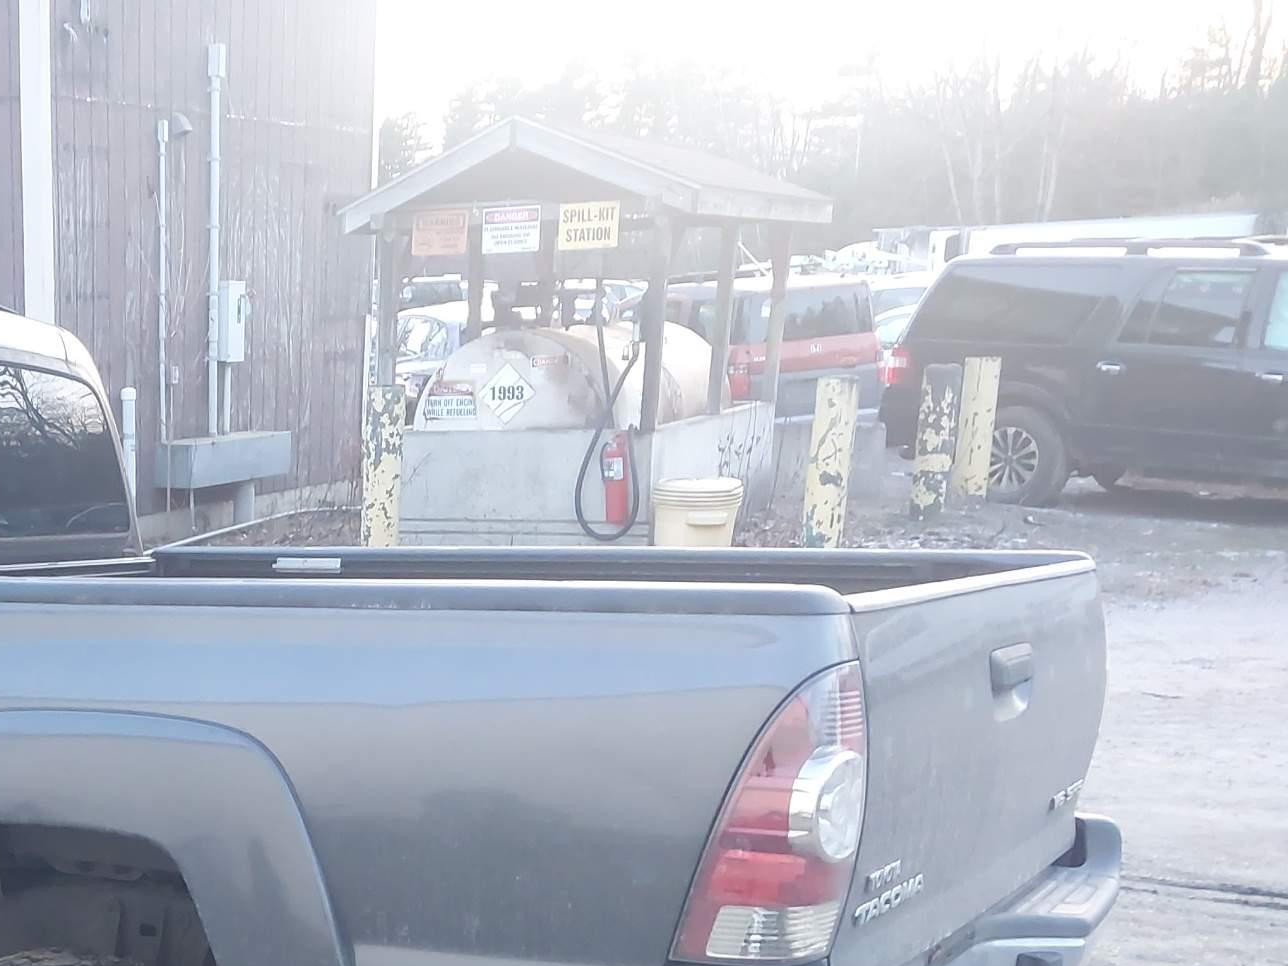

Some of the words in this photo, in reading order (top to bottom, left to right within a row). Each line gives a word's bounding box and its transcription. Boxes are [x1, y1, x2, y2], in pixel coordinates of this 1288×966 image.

[563, 207, 615, 224] SPILL-KIT
[565, 227, 611, 242] STATION
[490, 385, 524, 400] 1993
[456, 398, 475, 407] ENGIN
[426, 408, 443, 417] WHILE
[854, 873, 923, 925] TACOMA
